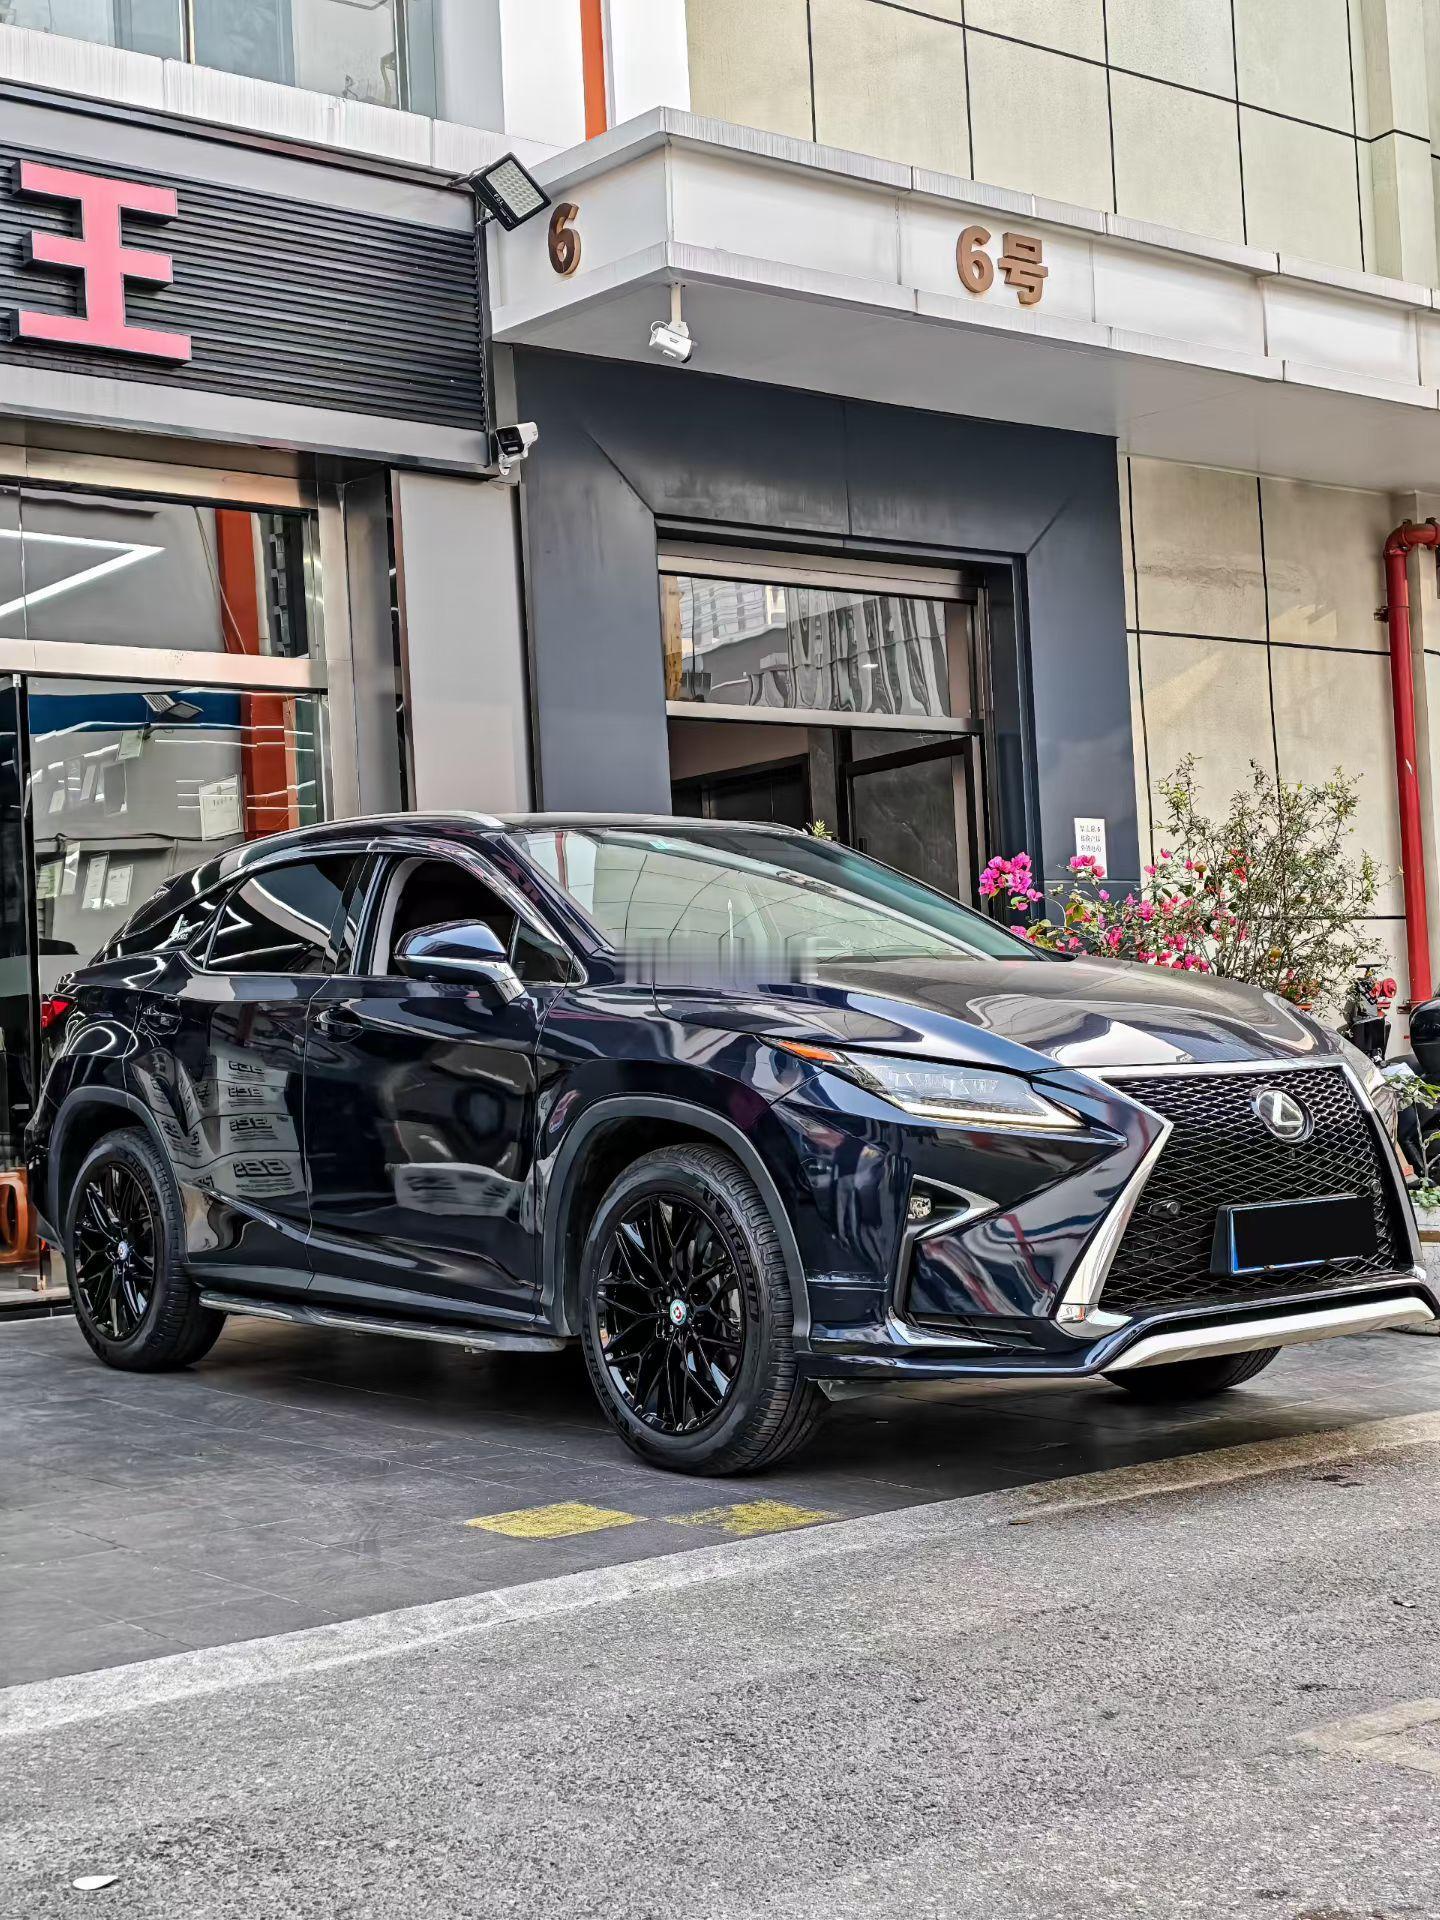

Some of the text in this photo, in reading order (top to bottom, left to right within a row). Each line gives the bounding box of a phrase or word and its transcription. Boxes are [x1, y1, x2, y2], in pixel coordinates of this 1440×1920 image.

[19, 159, 192, 361] 王
[548, 202, 581, 275] 6
[956, 225, 1048, 305] 6号
